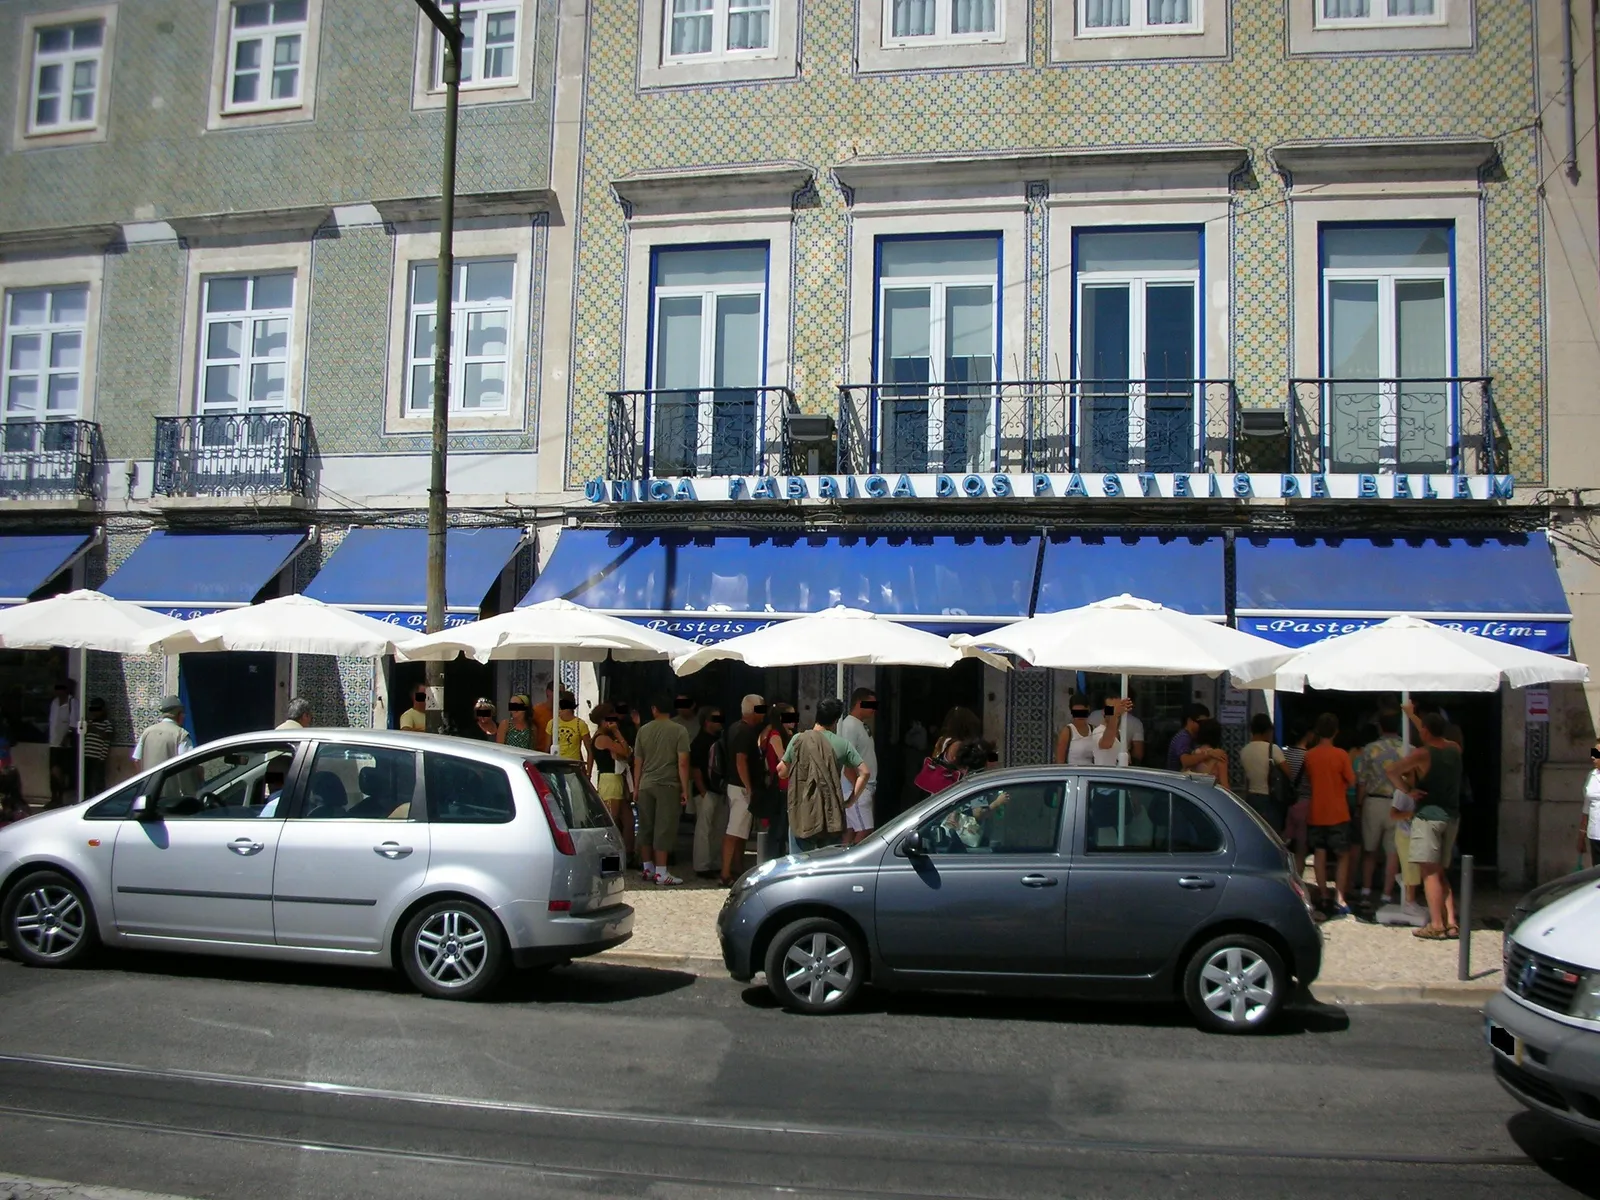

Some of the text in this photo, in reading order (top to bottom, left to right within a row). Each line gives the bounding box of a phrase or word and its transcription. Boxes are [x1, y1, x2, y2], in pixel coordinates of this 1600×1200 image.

[936, 473, 1011, 497] DOS
[1280, 473, 1325, 497] DE
[381, 613, 399, 625] de
